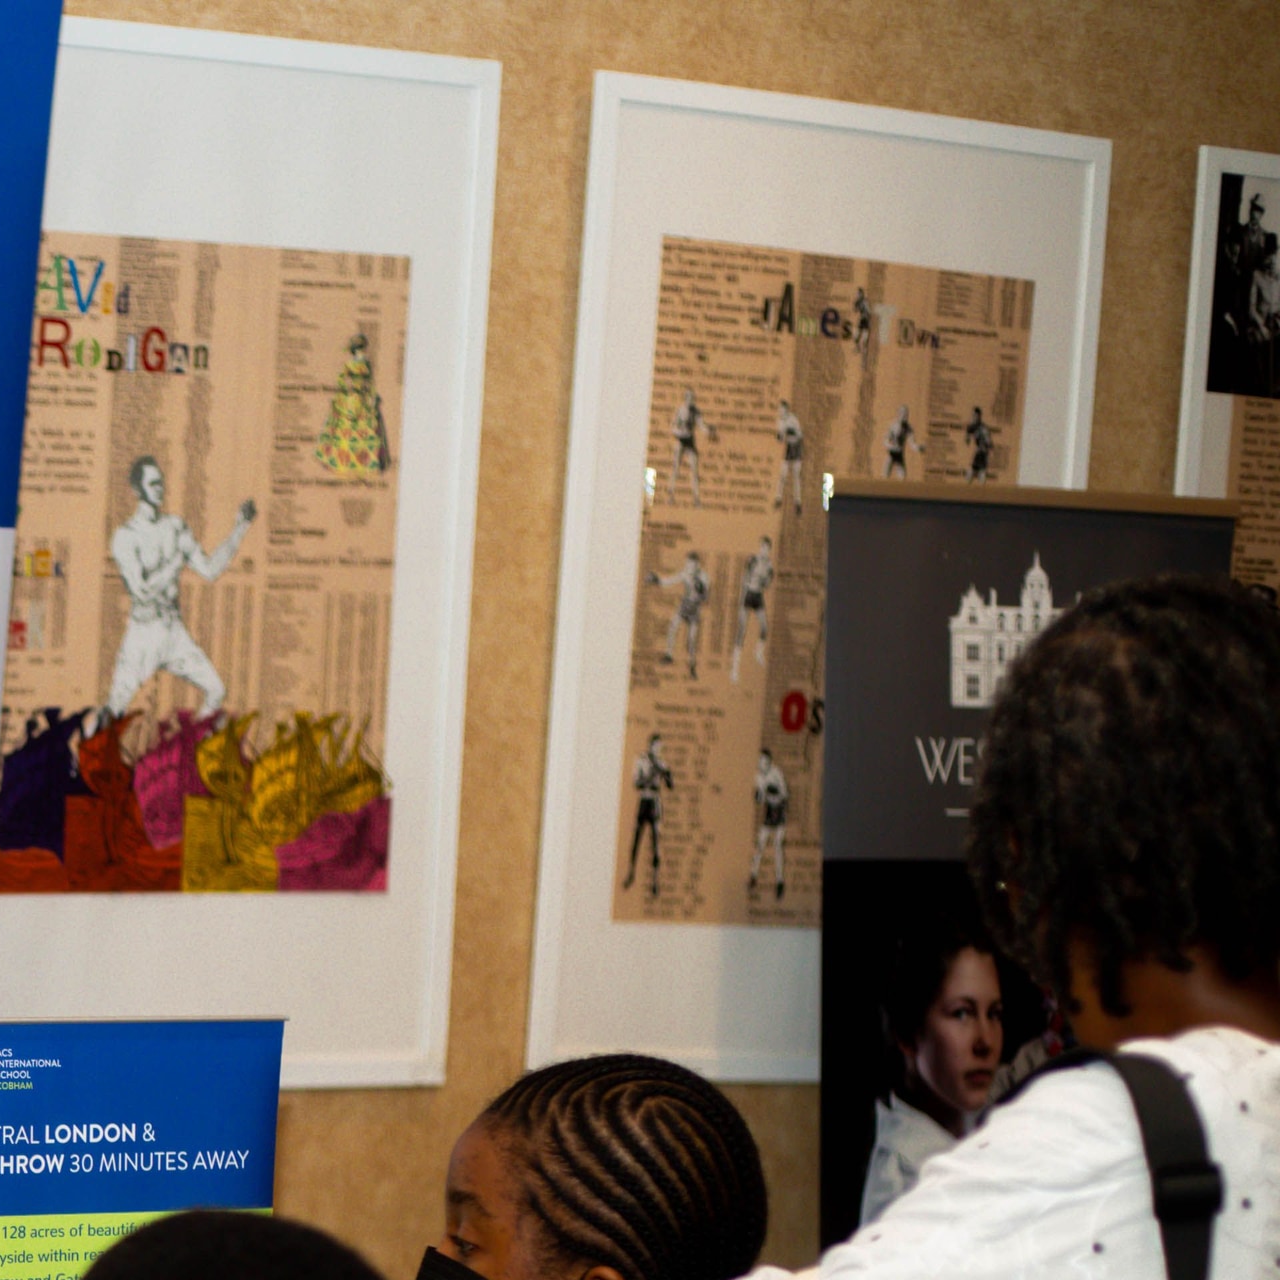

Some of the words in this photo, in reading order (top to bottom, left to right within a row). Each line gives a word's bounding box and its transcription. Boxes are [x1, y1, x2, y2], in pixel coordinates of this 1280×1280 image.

[45, 1123, 136, 1144] LONDON
[142, 1122, 156, 1142] &
[70, 1154, 93, 1173] 30
[99, 1151, 188, 1172] MINUTES
[192, 1150, 249, 1170] AWAY
[2, 1225, 26, 1239] 128
[30, 1227, 65, 1238] acres
[69, 1223, 84, 1237] of
[87, 1222, 142, 1237] beautif
[38, 1248, 79, 1262] within
